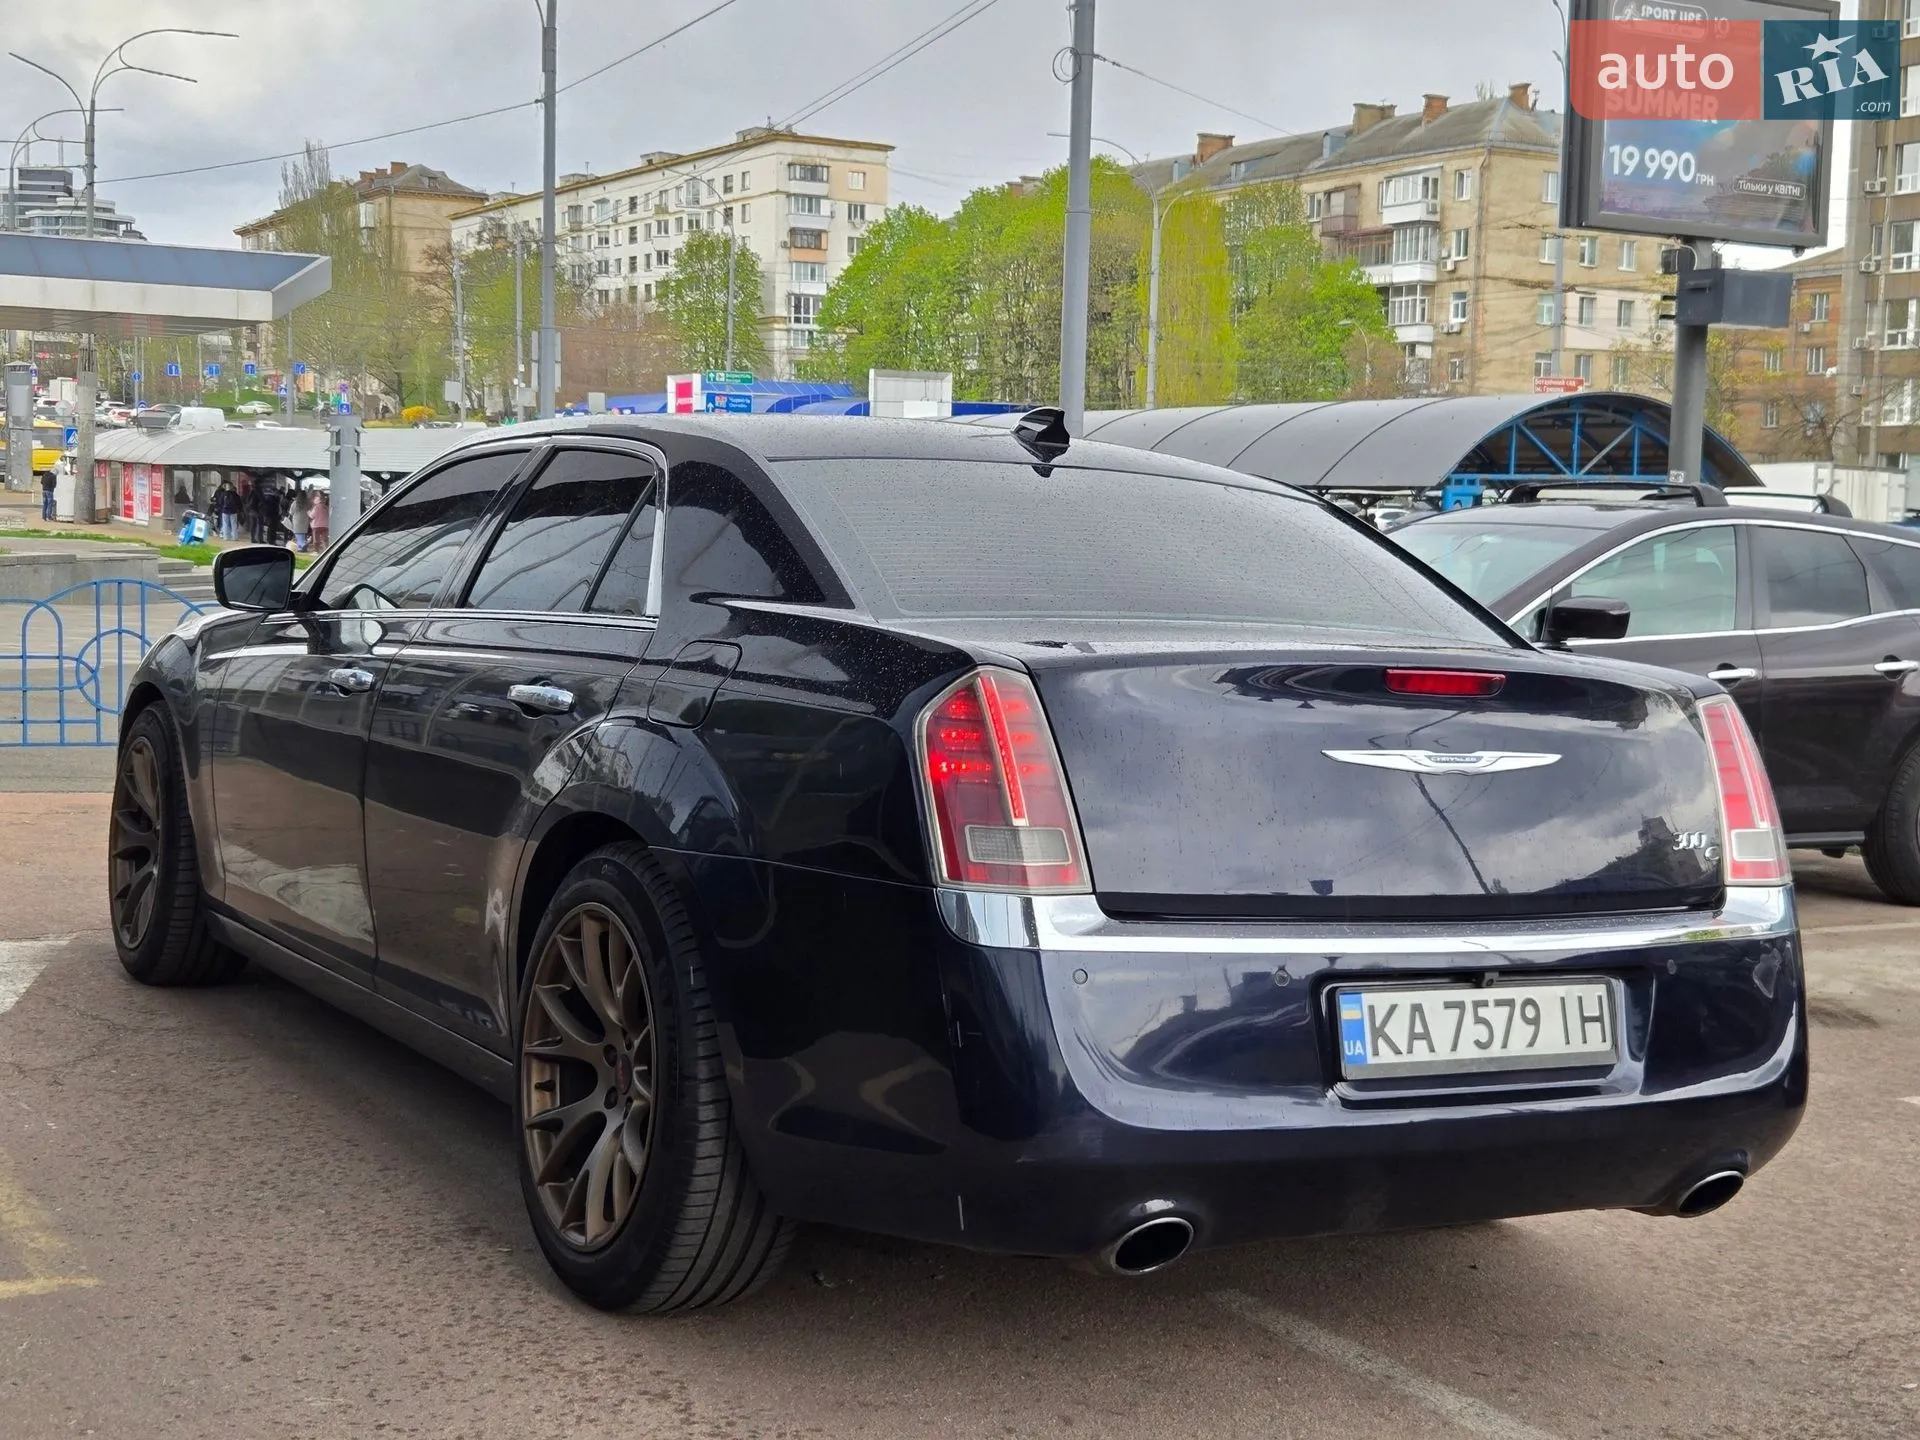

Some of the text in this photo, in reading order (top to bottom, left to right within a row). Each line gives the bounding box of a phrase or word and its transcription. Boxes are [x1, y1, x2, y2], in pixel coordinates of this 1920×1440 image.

[1640, 5, 1677, 20] SPORT
[1606, 88, 1719, 125] SUMMER
[1609, 144, 1641, 176] 19
[1644, 148, 1696, 183] 990
[1672, 832, 1707, 850] 300
[1367, 994, 1608, 1057] KA 7579 IH
[1344, 1040, 1365, 1057] UA
